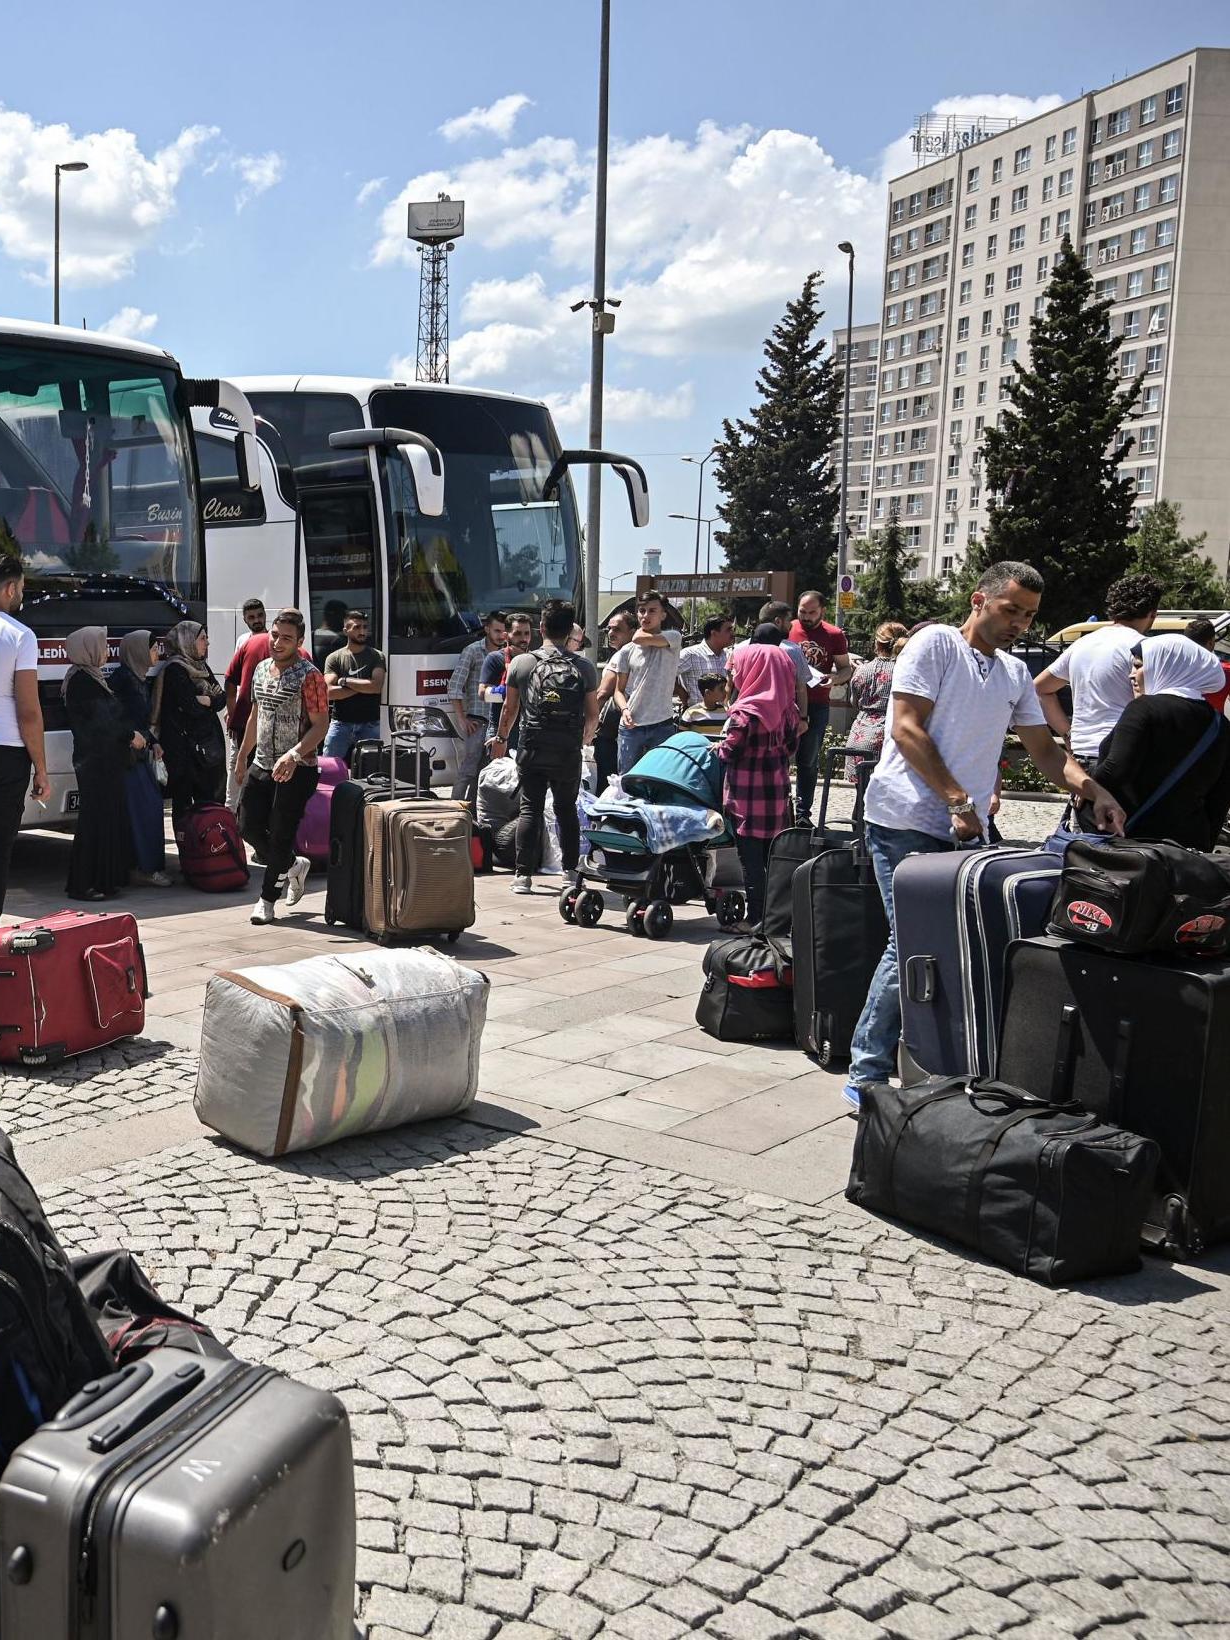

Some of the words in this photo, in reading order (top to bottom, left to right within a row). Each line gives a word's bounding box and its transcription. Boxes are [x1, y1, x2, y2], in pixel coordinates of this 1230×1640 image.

[218, 411, 238, 423] TRAV
[148, 503, 183, 521] Busin
[203, 498, 242, 520] Class
[37, 645, 67, 659] LEDİY
[423, 679, 451, 687] ESENY
